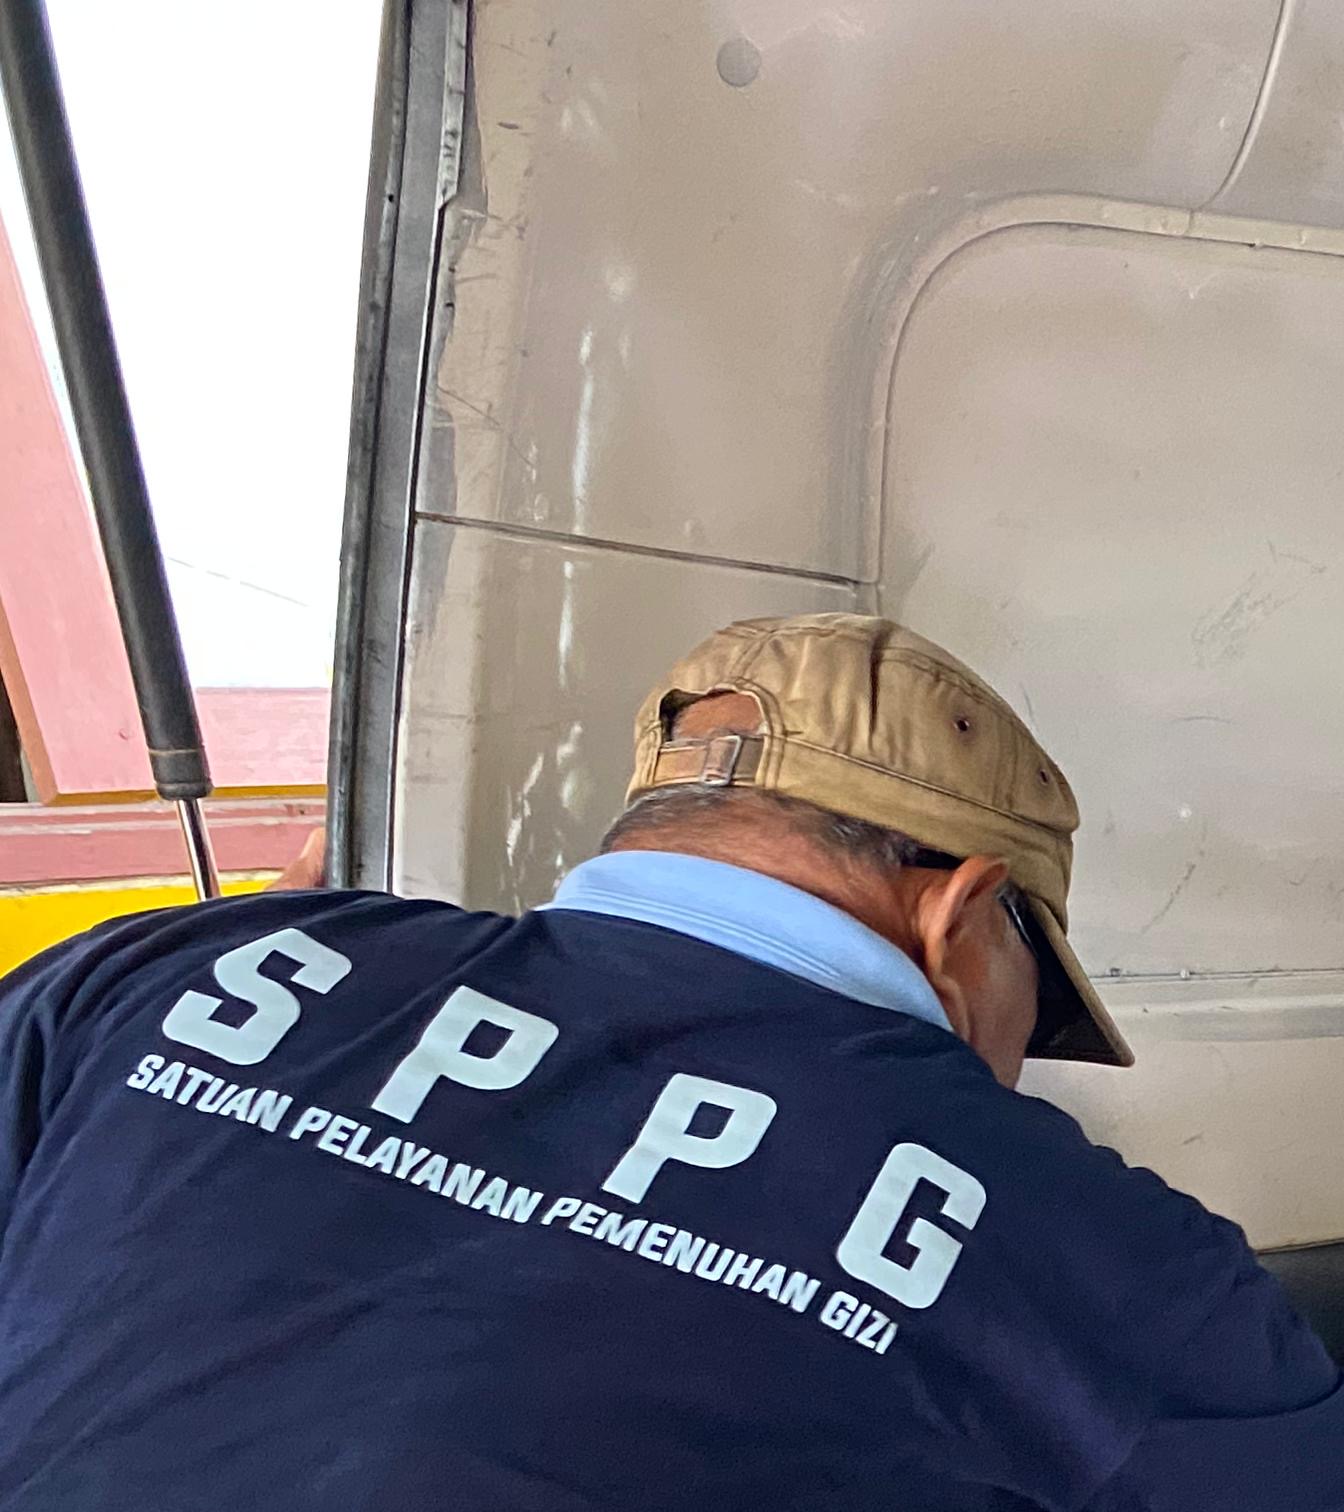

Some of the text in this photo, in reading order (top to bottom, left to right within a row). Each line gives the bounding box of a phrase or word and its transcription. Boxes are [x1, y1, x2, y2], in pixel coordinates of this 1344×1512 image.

[126, 1053, 900, 1356] SATUAN PELAYANAN PEMENUHAN GIZI
[161, 926, 987, 1310] S P P G
